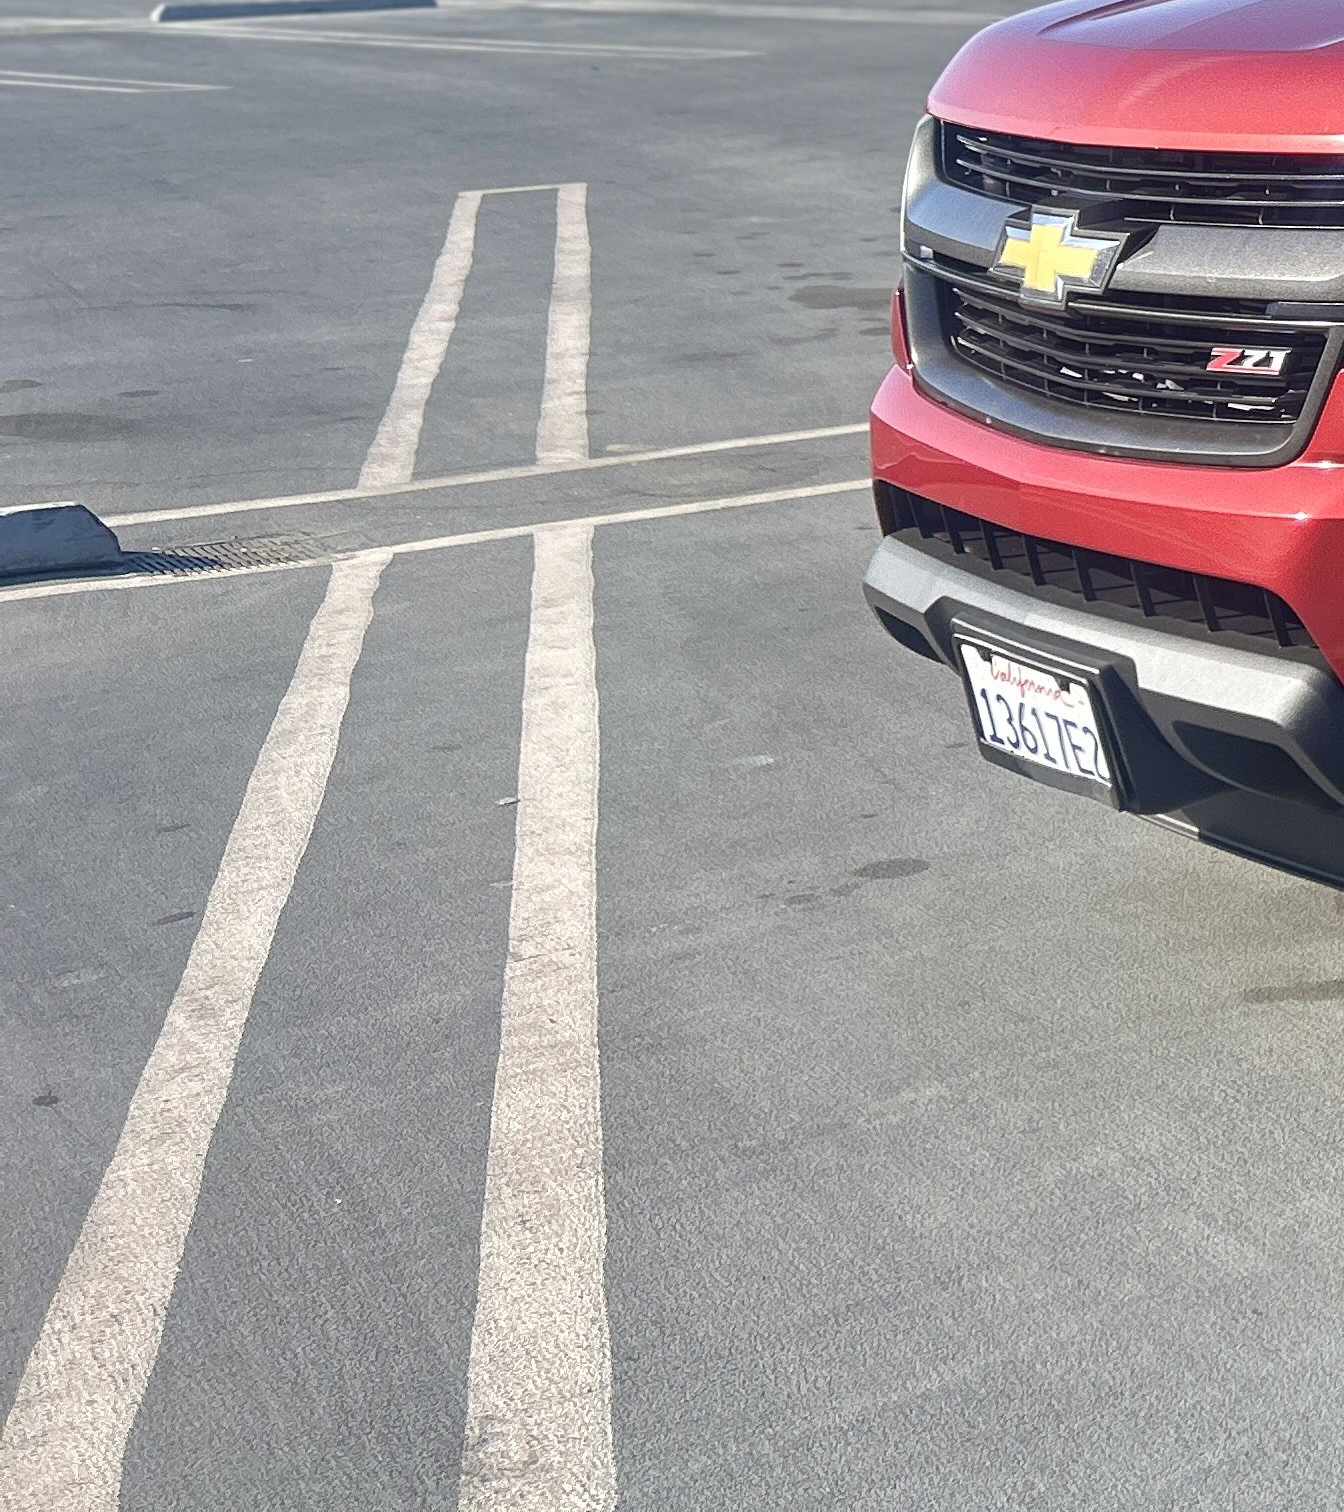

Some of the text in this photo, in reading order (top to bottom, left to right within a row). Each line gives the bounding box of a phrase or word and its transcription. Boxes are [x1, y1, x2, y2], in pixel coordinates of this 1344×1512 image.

[1205, 346, 1293, 376] Z71
[989, 653, 1075, 708] California
[979, 687, 1112, 782] 13617E2
